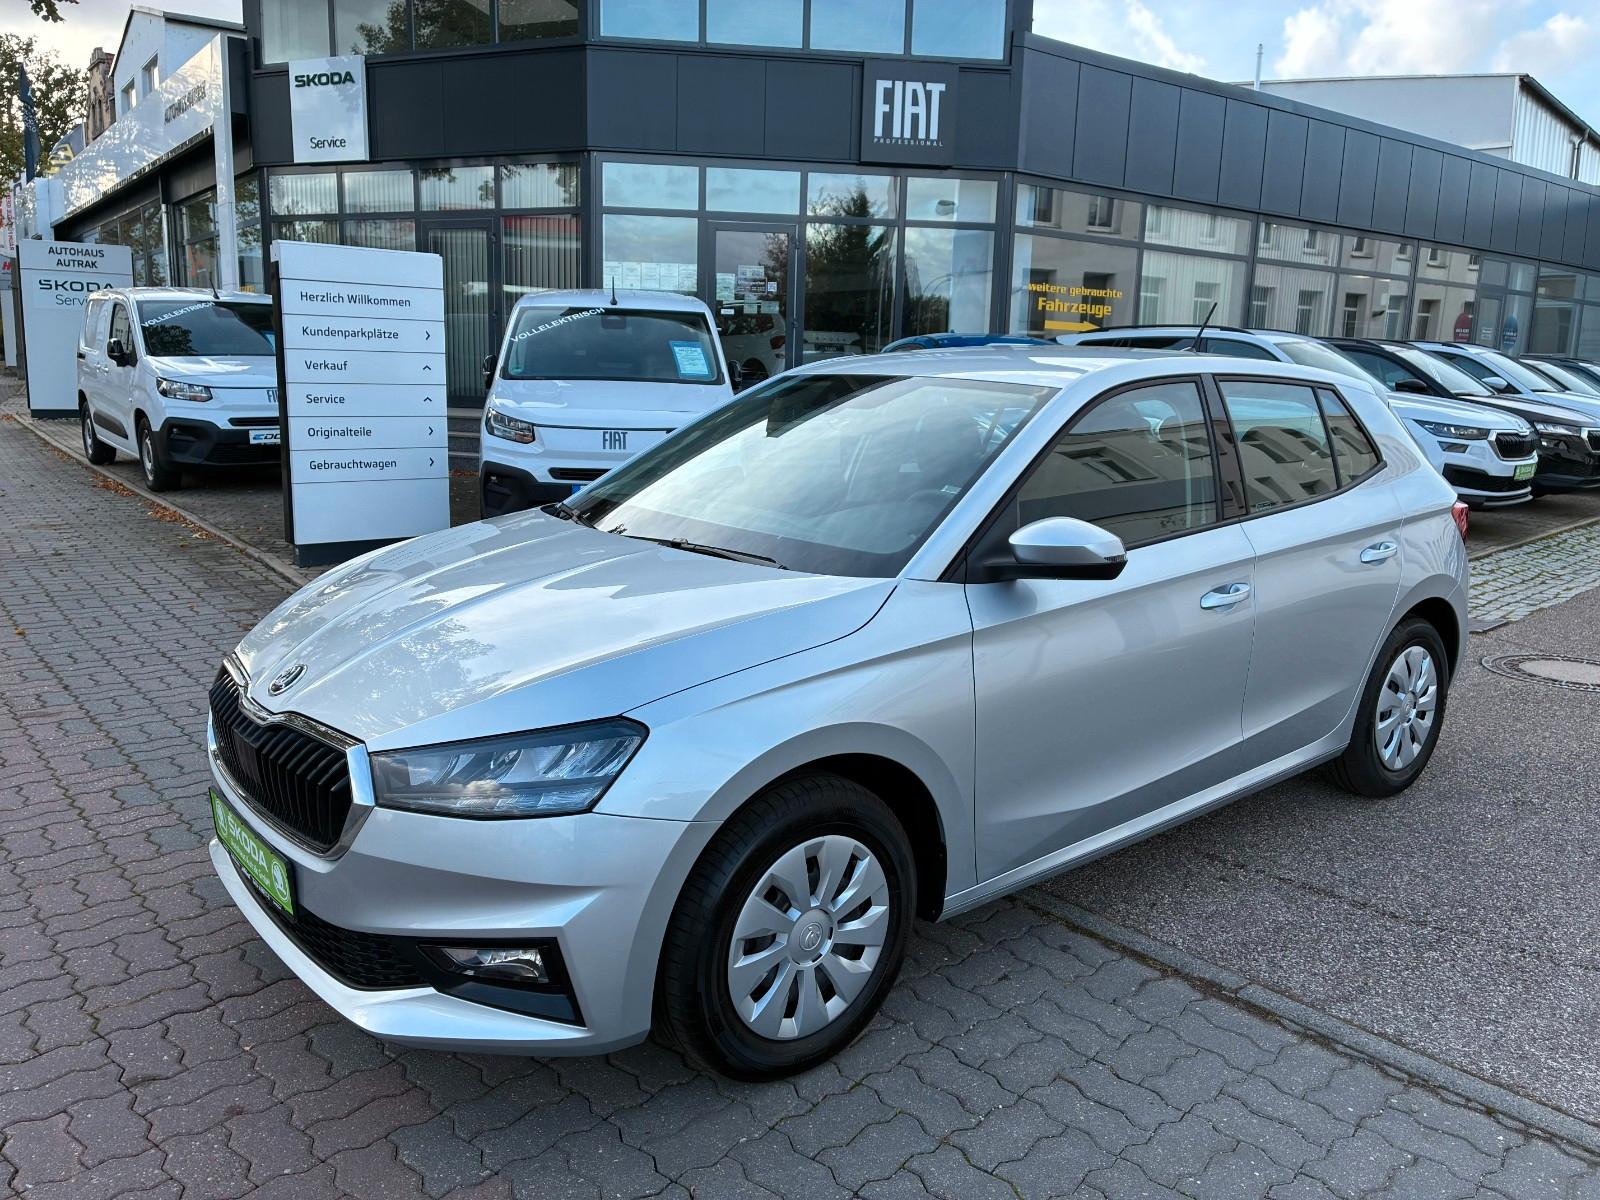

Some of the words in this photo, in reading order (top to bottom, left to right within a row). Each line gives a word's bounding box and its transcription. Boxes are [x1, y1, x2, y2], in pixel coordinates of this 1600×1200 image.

[294, 70, 355, 88] SKODA
[874, 79, 946, 140] FIAT
[309, 135, 346, 150] Service
[873, 138, 943, 147] PROFESSIONAL
[47, 246, 105, 258] AUTOHAUS
[56, 258, 98, 269] AUTRAK
[1028, 282, 1067, 294] weitere
[1069, 286, 1123, 298] gebrauchte
[55, 293, 88, 306] Servi
[300, 291, 344, 304] Herzlich
[347, 294, 411, 307] Willkommen
[1037, 296, 1112, 318] Fahrzeuge
[140, 301, 216, 328] VOLLELEKTRISCH
[509, 307, 606, 342] VOLLELEKTRISCH
[302, 326, 399, 340] Kundenparkplätze
[304, 360, 348, 371] Verkauf
[306, 394, 346, 404] Service
[307, 426, 372, 439] Originalteile
[602, 430, 628, 450] FIAT
[309, 459, 397, 471] Gebrauchtwagen
